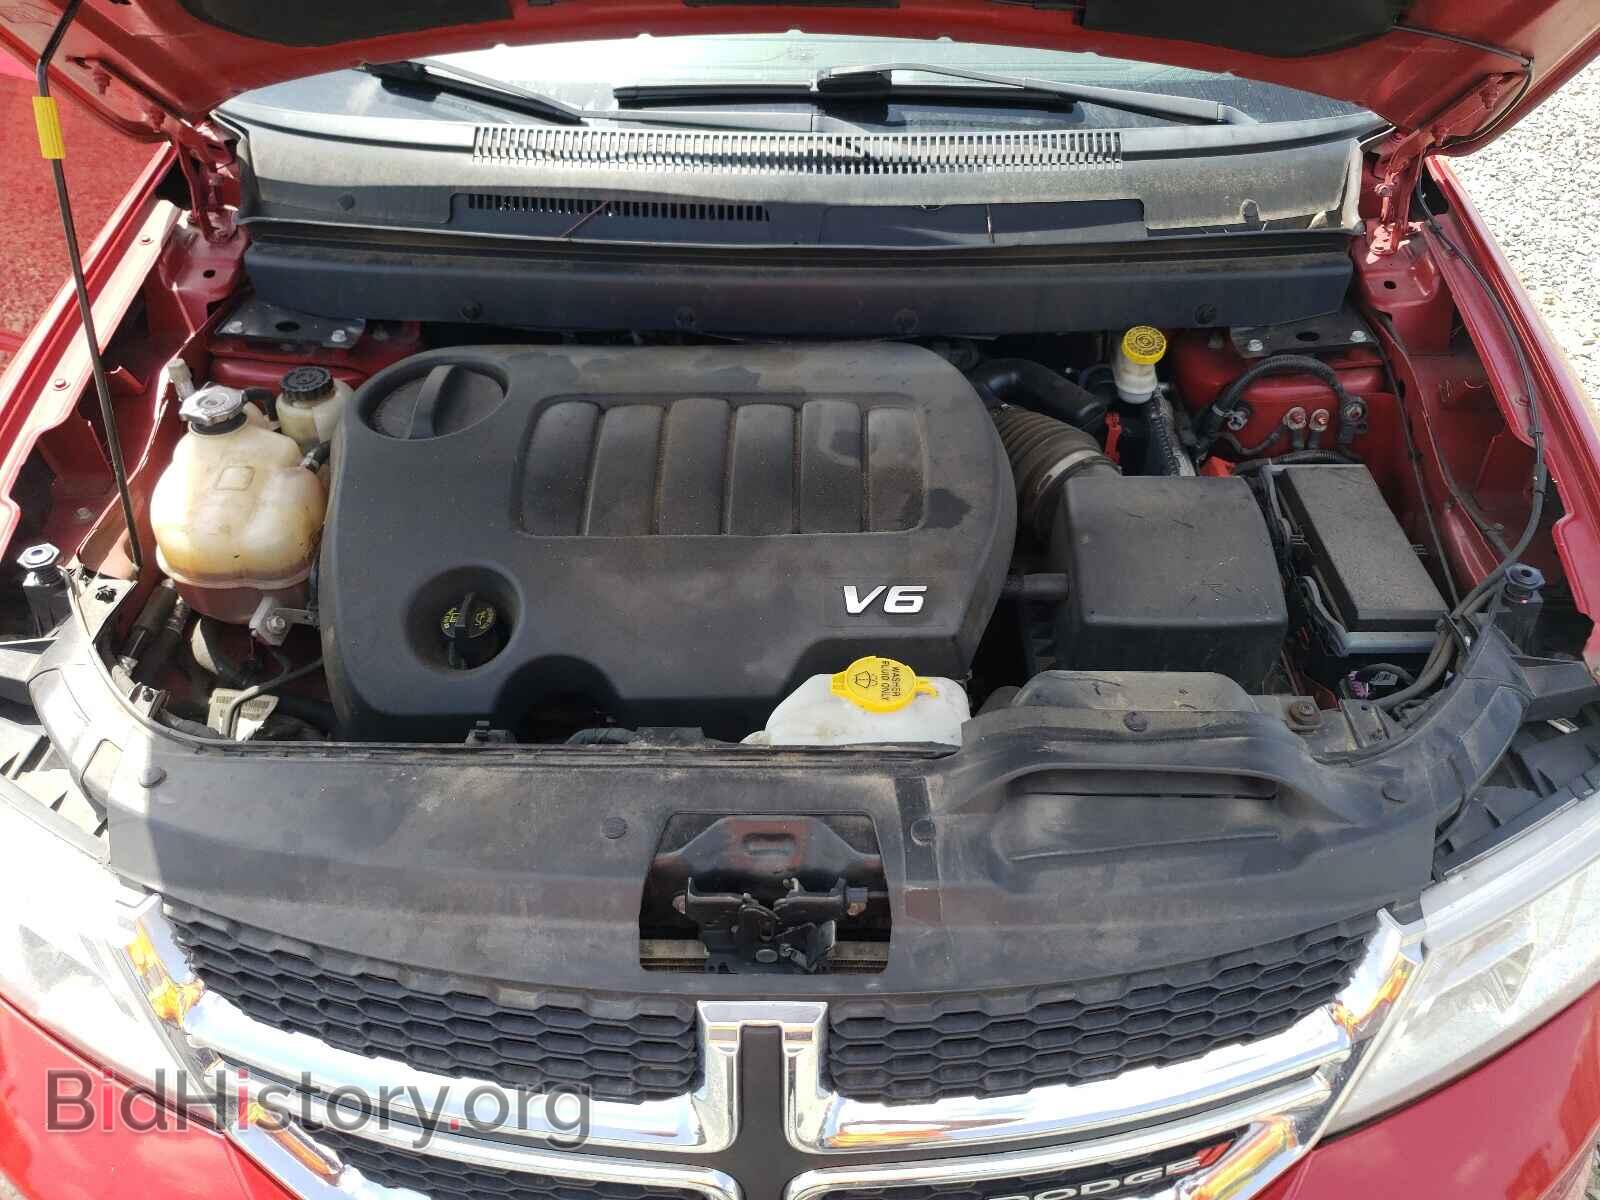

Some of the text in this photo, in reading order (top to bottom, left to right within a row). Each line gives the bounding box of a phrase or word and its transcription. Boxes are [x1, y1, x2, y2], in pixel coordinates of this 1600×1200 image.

[843, 585, 928, 614] V6
[880, 660, 890, 701] FLUID ONLY
[891, 666, 901, 697] WASHER
